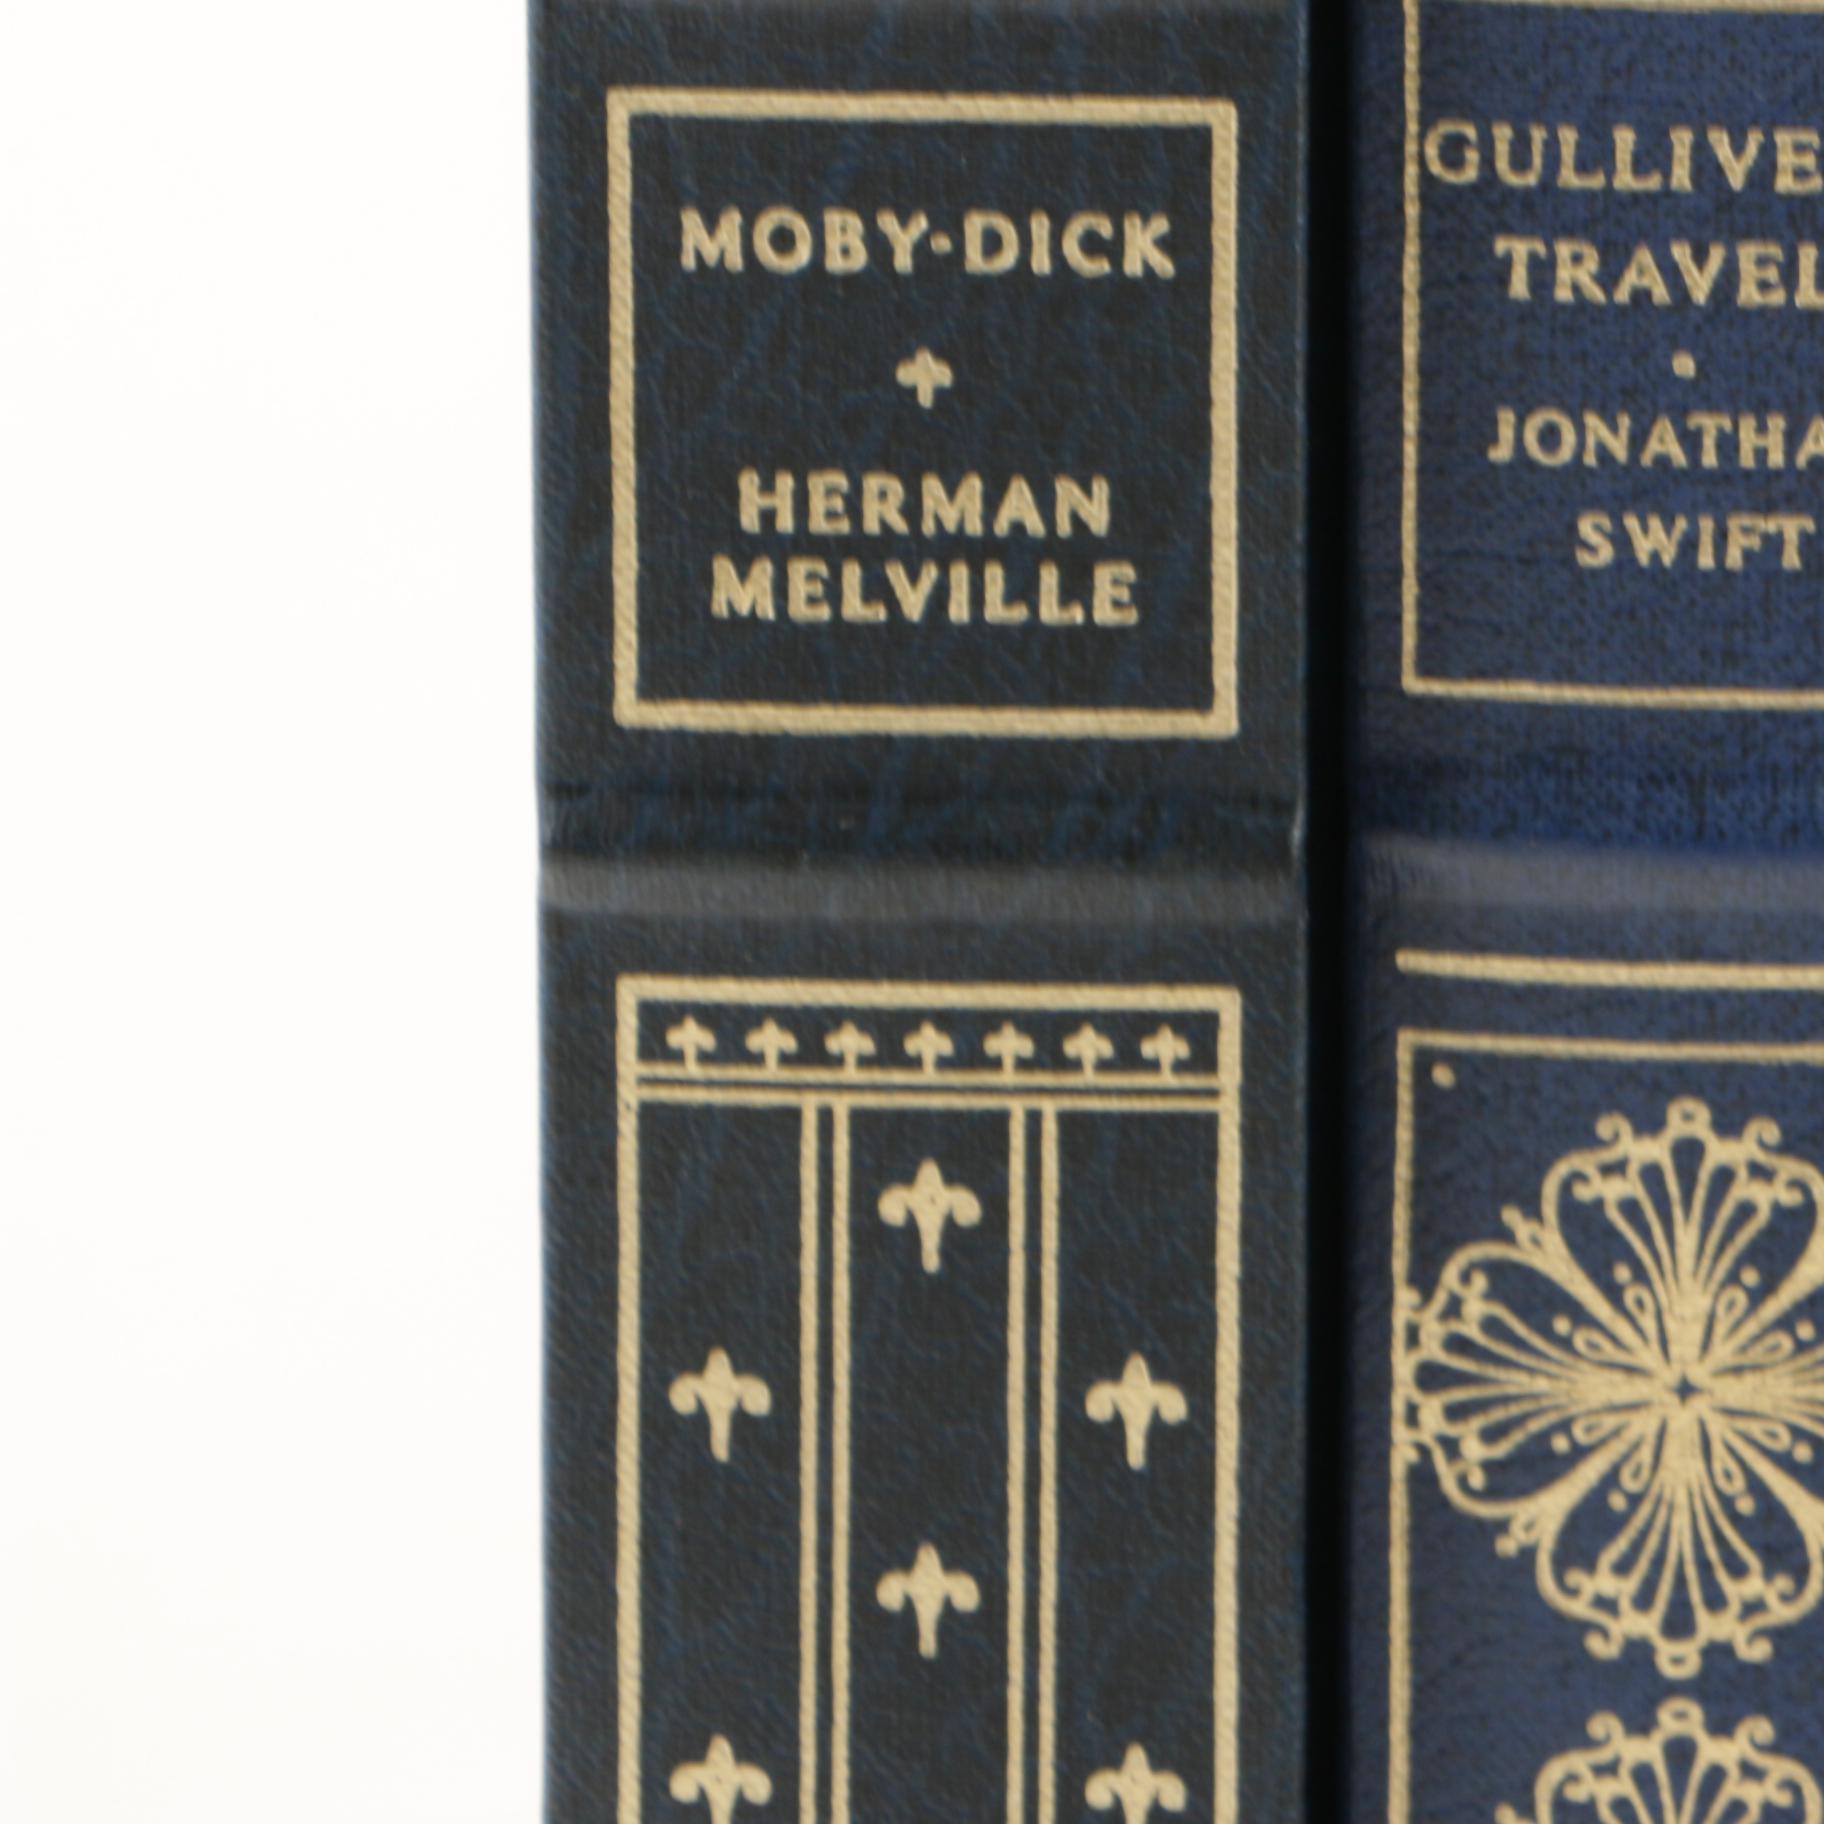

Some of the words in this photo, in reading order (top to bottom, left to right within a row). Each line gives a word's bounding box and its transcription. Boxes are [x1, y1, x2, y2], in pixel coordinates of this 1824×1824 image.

[738, 469, 1110, 538] HERMAN
[1576, 512, 1816, 571] SWIFT
[711, 555, 1139, 626] MELVILLE
